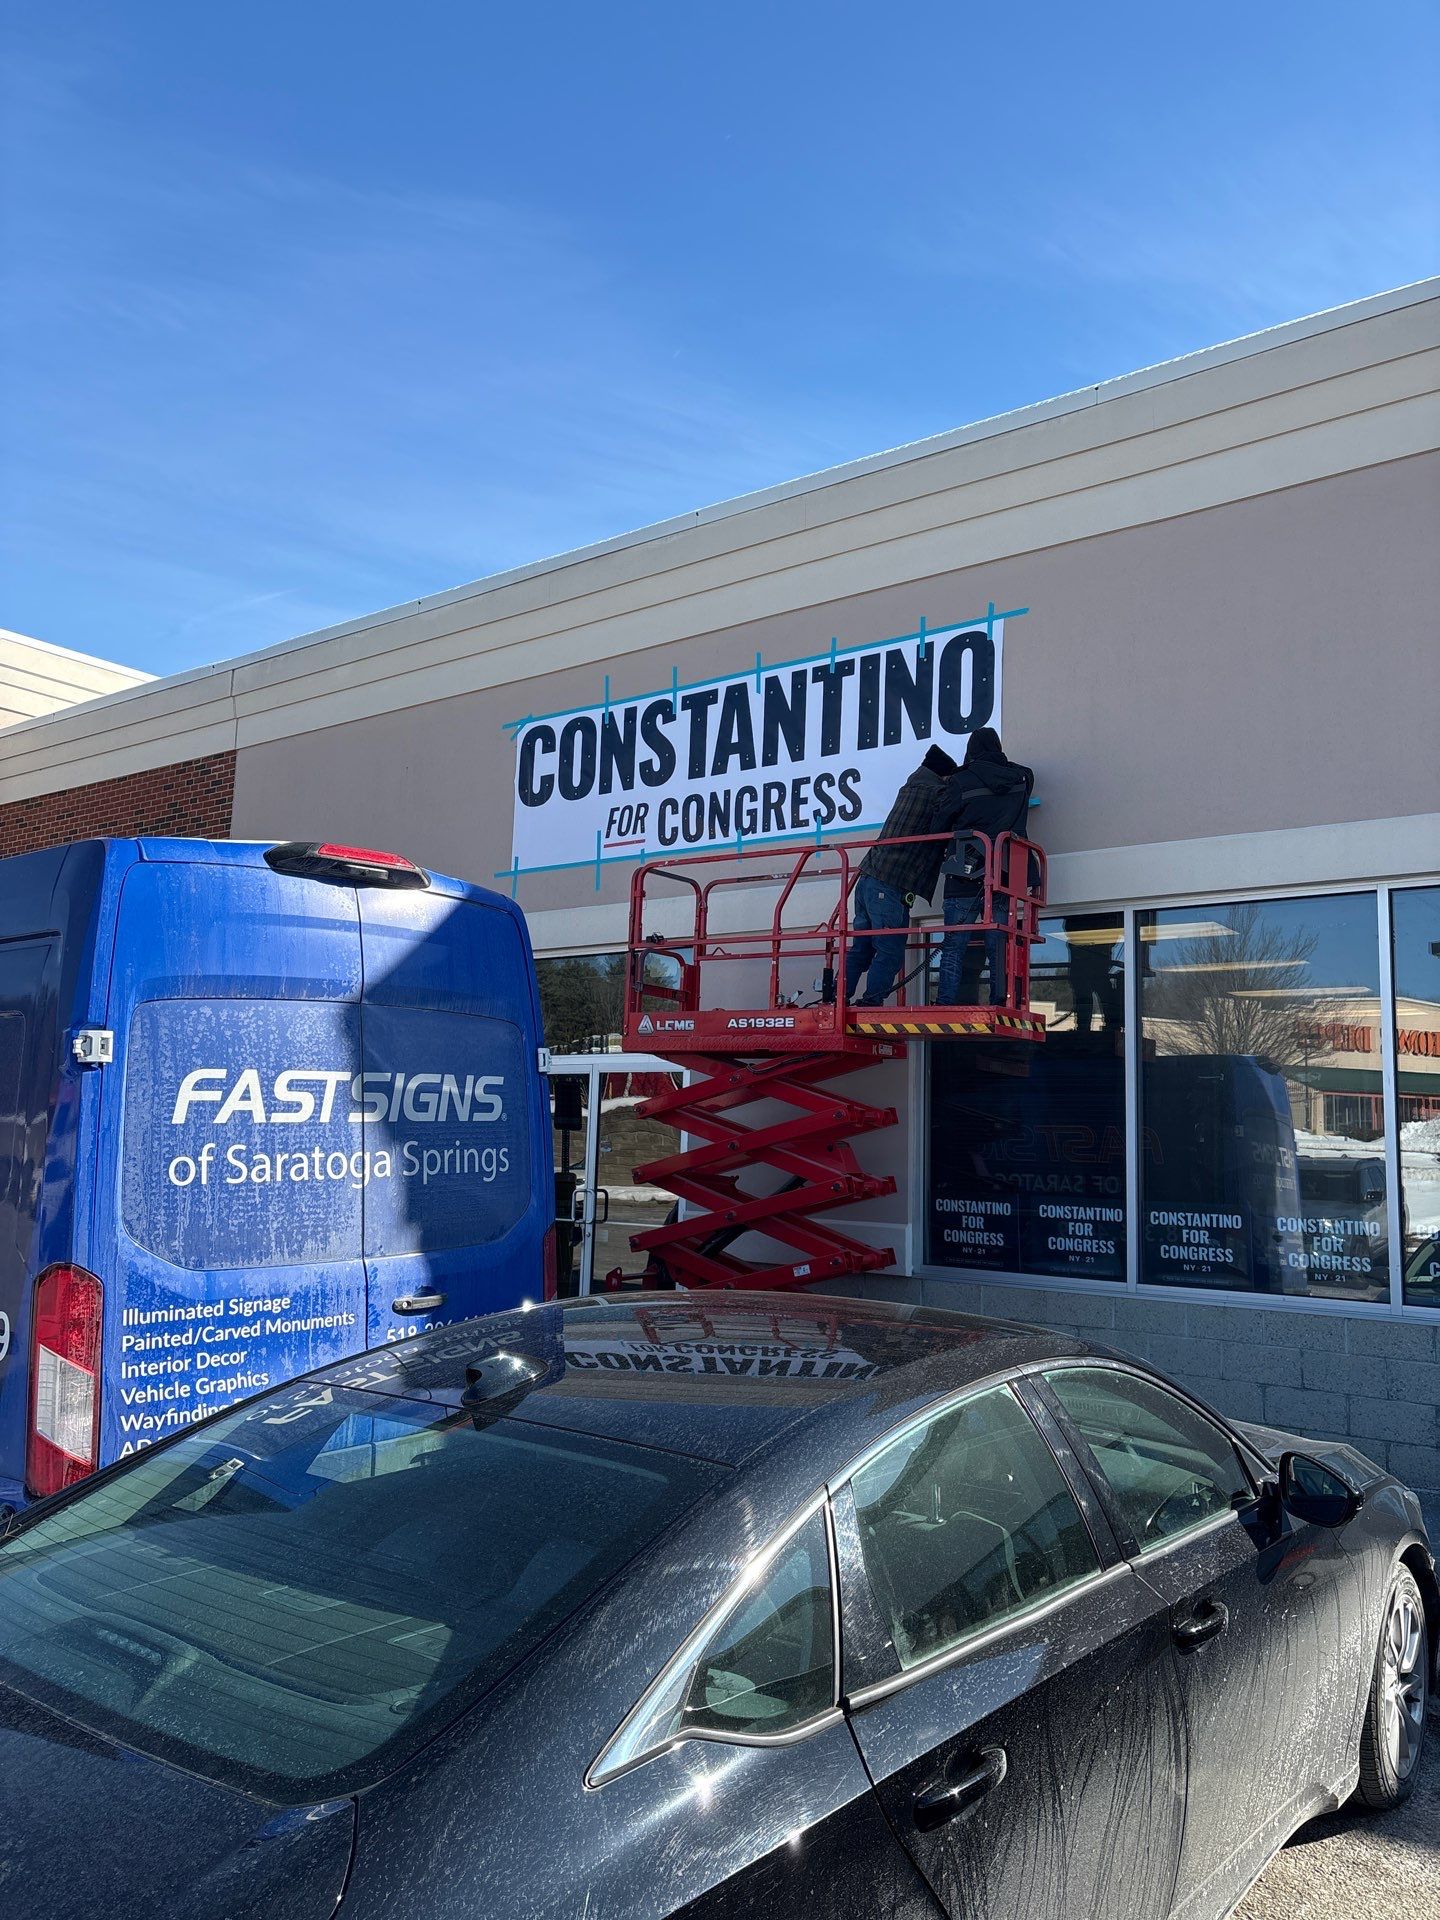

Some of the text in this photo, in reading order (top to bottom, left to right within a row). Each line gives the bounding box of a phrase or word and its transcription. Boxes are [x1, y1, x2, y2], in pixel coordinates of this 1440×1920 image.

[517, 630, 995, 808] CONSTANTINO
[604, 768, 863, 847] FOR CONGRESS
[656, 1017, 795, 1031] LCMG AS1932E
[171, 1068, 505, 1124] FASTSIGNS
[168, 1140, 510, 1189] of Saratoga Springs
[935, 1198, 1012, 1216] CONSTANTINO
[1038, 1204, 1123, 1223] CONSTANTINO
[961, 1215, 985, 1229] FOR
[1149, 1210, 1242, 1229] CONSTANTINO
[1276, 1216, 1380, 1237] CONSTANTINO
[943, 1229, 1005, 1246] CONGRESS
[1068, 1222, 1093, 1237] FOR
[1182, 1229, 1210, 1244] FOR
[1047, 1236, 1115, 1255] CONGRESS
[1160, 1244, 1234, 1263] CONGRESS
[1313, 1236, 1344, 1253] FOR
[1288, 1252, 1372, 1273] CONGRESS
[122, 1297, 291, 1326] Illuminated Signage
[122, 1311, 355, 1352] Painted/Carved Monuments
[121, 1350, 248, 1379] Interior Decor
[120, 1370, 270, 1405] Vehicle Graphics
